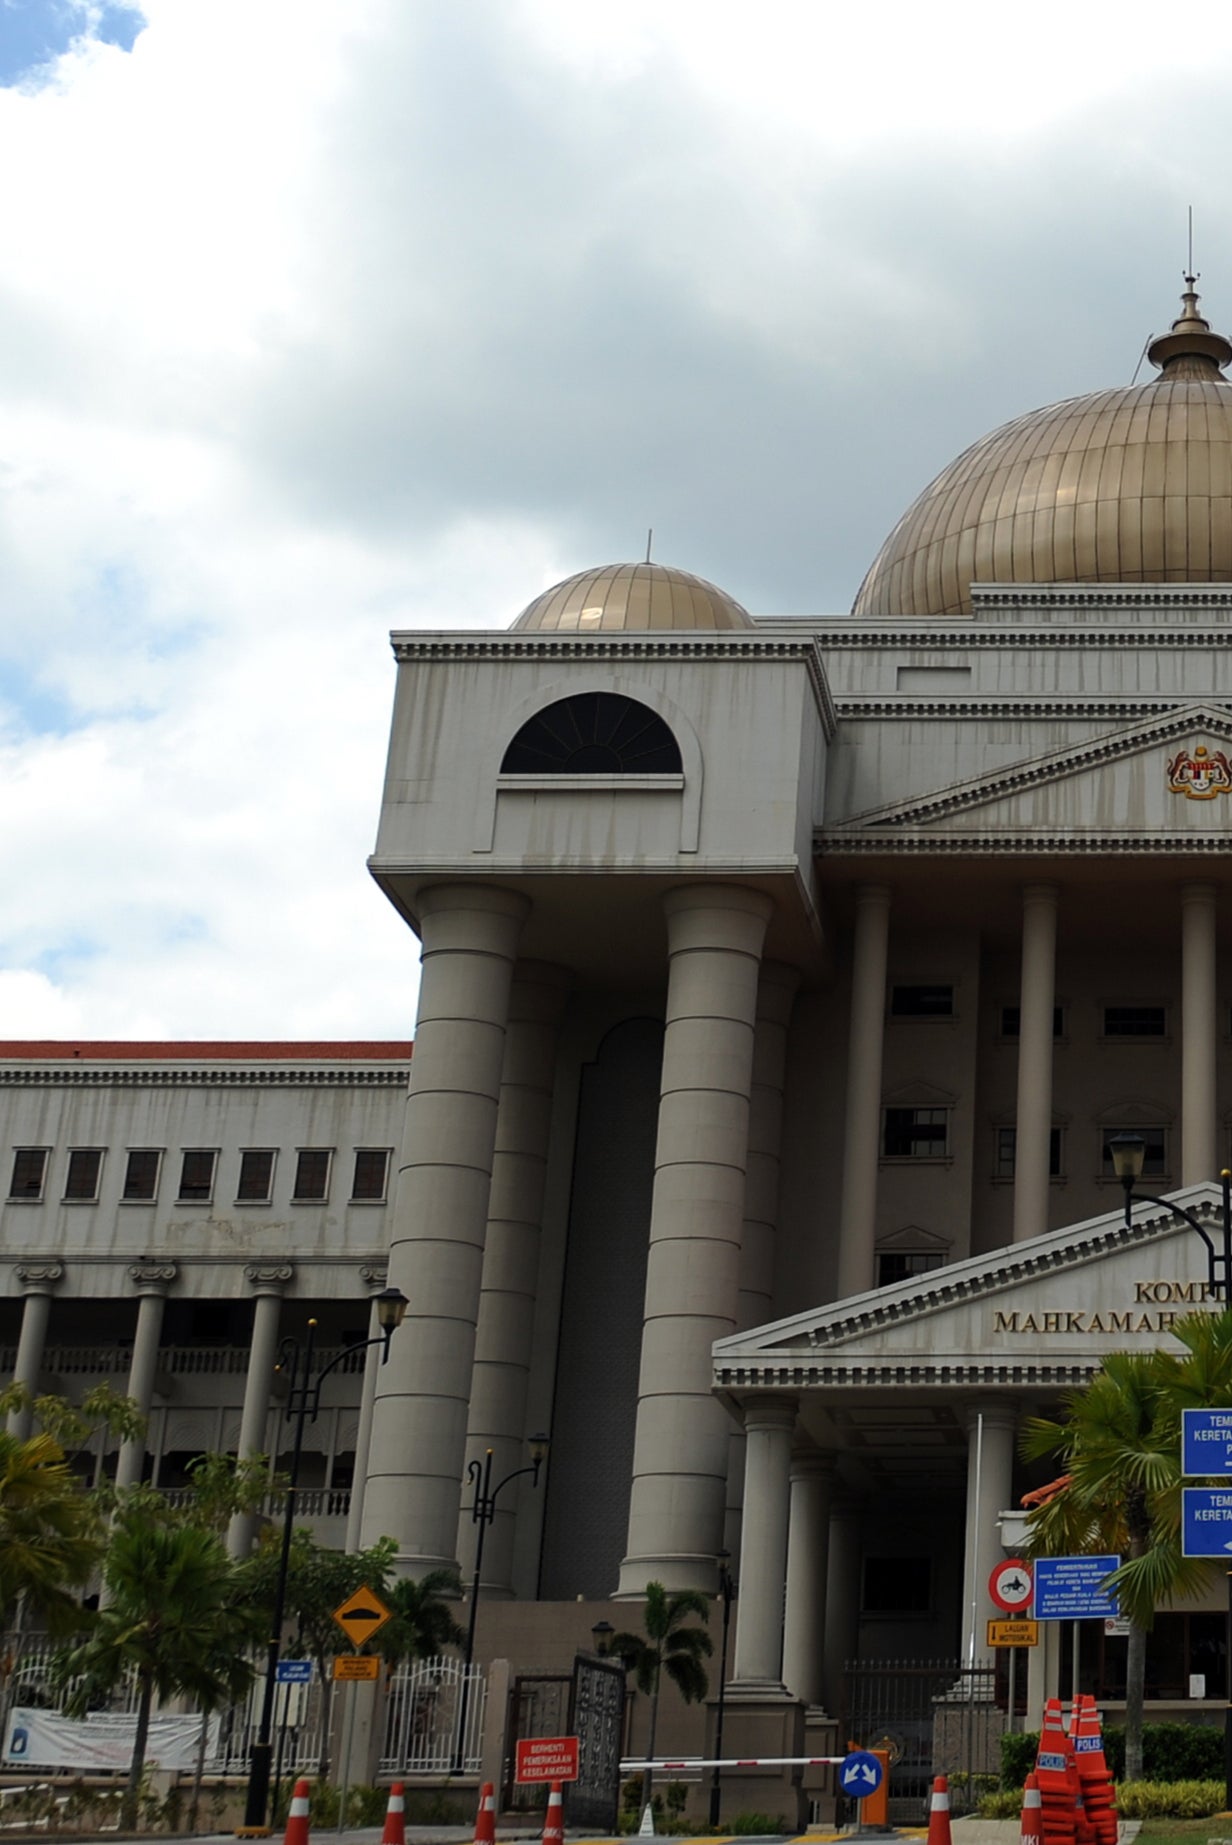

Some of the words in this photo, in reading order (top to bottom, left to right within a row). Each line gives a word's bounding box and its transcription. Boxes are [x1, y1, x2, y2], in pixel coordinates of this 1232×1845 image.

[993, 1311, 1177, 1333] MAHKAMAH
[1194, 1429, 1232, 1441] KERETA
[1194, 1509, 1232, 1521] KERETA
[1077, 1739, 1100, 1752] POLIS
[1039, 1754, 1064, 1769] POLIS
